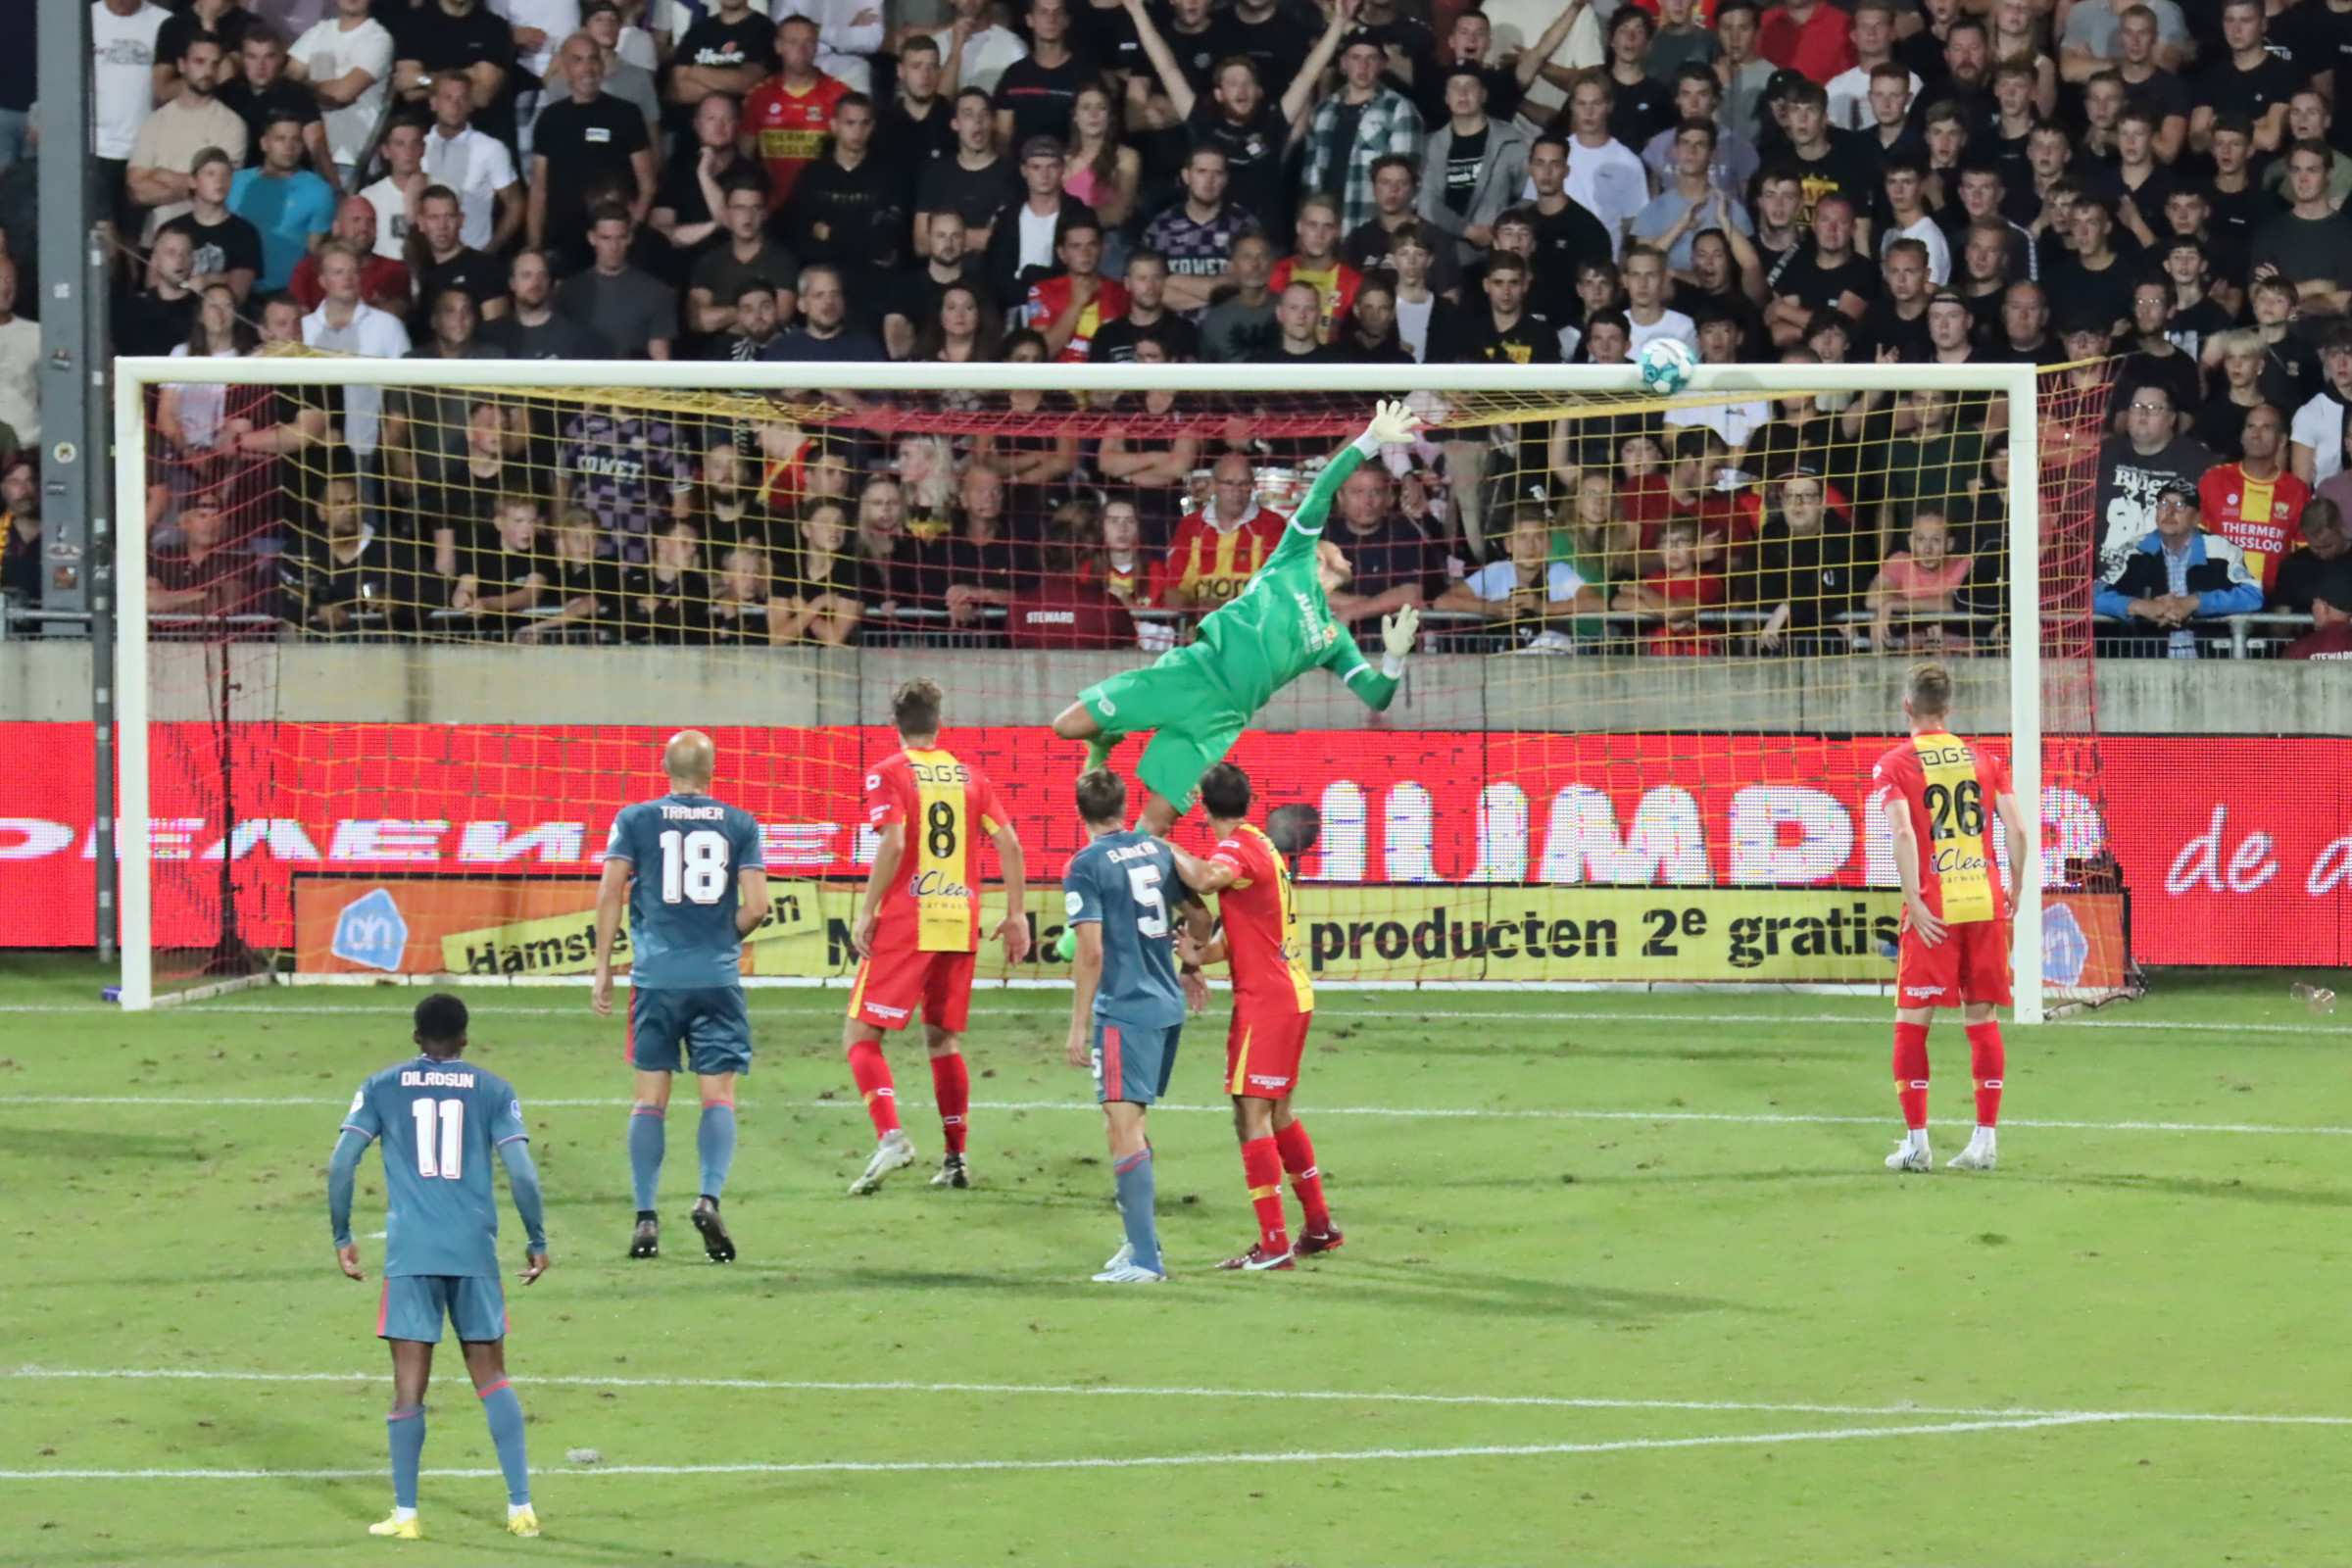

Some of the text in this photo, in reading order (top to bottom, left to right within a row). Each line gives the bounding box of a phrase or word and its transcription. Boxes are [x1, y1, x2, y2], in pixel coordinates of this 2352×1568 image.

[2222, 521, 2284, 539] THERMEN
[2223, 534, 2282, 554] USSLOO
[1026, 612, 1075, 623] STEWARD
[661, 805, 724, 821] TRAUNER
[928, 800, 956, 859] 8
[1923, 779, 1986, 841] 26
[660, 830, 729, 905] 18
[2164, 804, 2280, 896] de
[1127, 864, 1169, 939] 5
[1310, 906, 1618, 971] producten
[1730, 903, 1899, 968] gratis
[412, 1097, 465, 1180] 11
